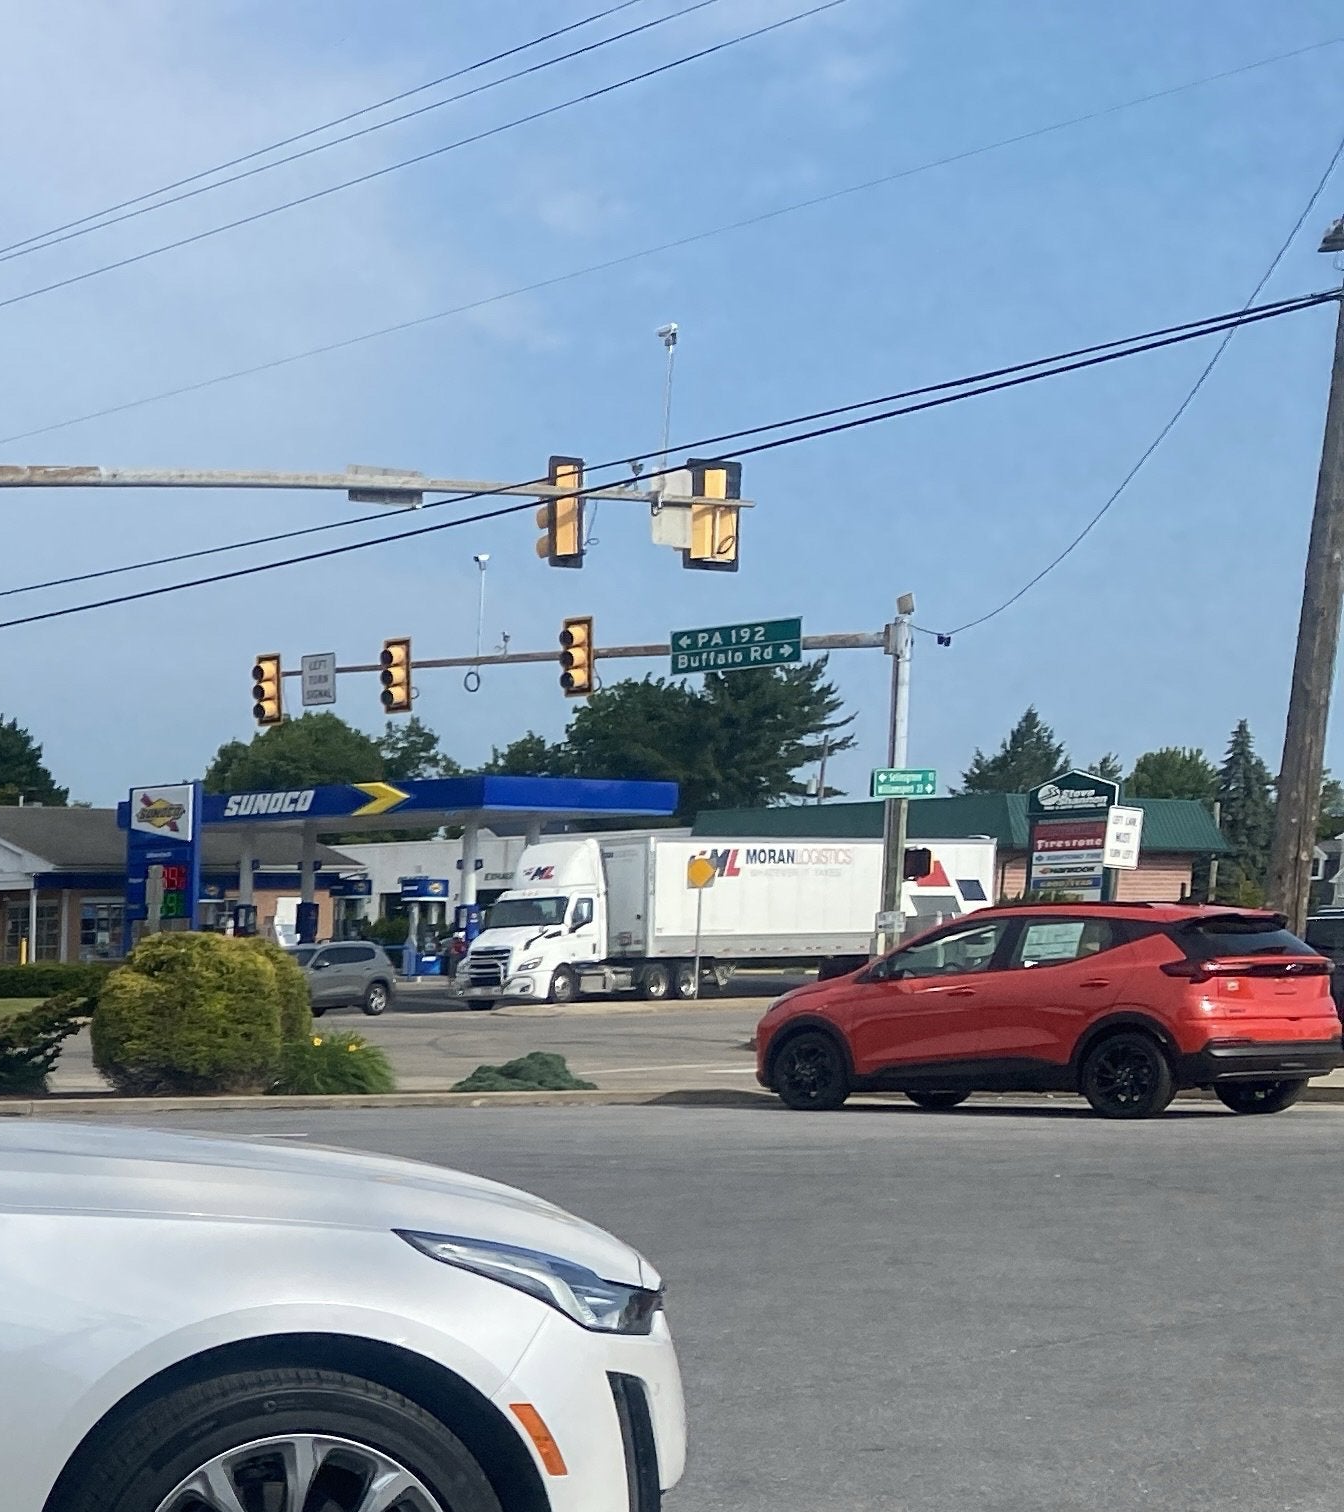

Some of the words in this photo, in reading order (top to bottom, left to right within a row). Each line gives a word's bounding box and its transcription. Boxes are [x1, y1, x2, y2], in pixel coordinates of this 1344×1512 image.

[697, 632, 724, 648] PA
[730, 626, 766, 644] 192
[677, 649, 744, 669] Buffalo
[750, 645, 773, 662] Rd
[224, 789, 316, 817] SUNOCO
[1036, 838, 1103, 851] Firestone
[745, 849, 795, 865] MORAN
